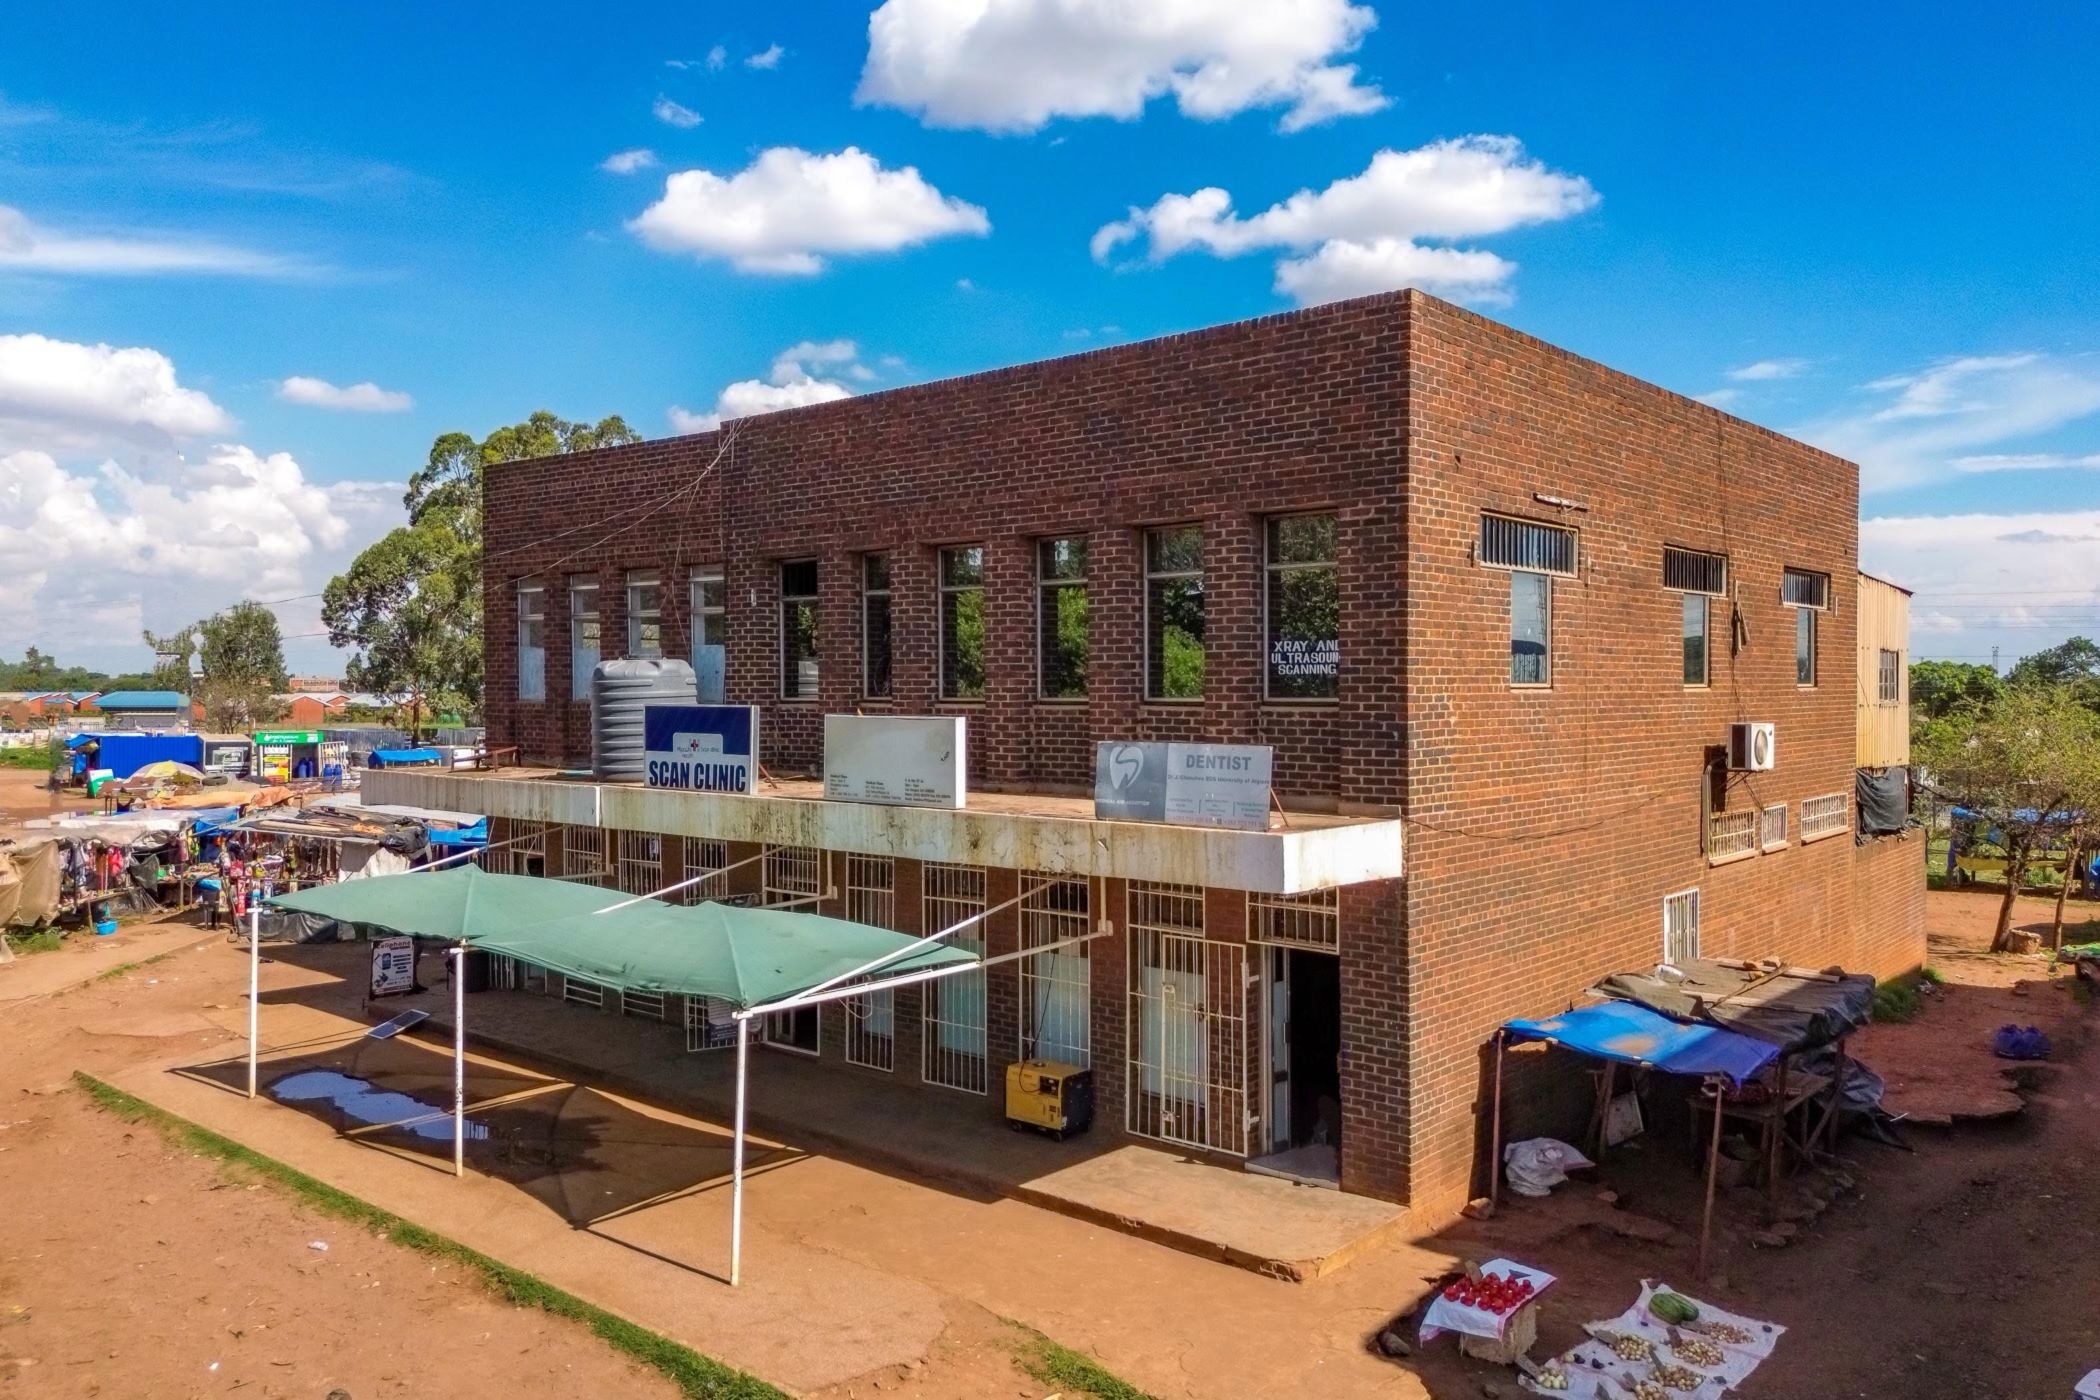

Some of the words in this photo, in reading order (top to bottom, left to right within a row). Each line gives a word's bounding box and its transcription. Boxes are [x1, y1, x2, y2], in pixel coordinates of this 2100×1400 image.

[1274, 641, 1308, 652] XRAY
[1278, 663, 1337, 675] SCANNING
[1187, 755, 1252, 769] DENTIST
[649, 760, 690, 788] SCAN
[694, 763, 746, 792] CLINIC
